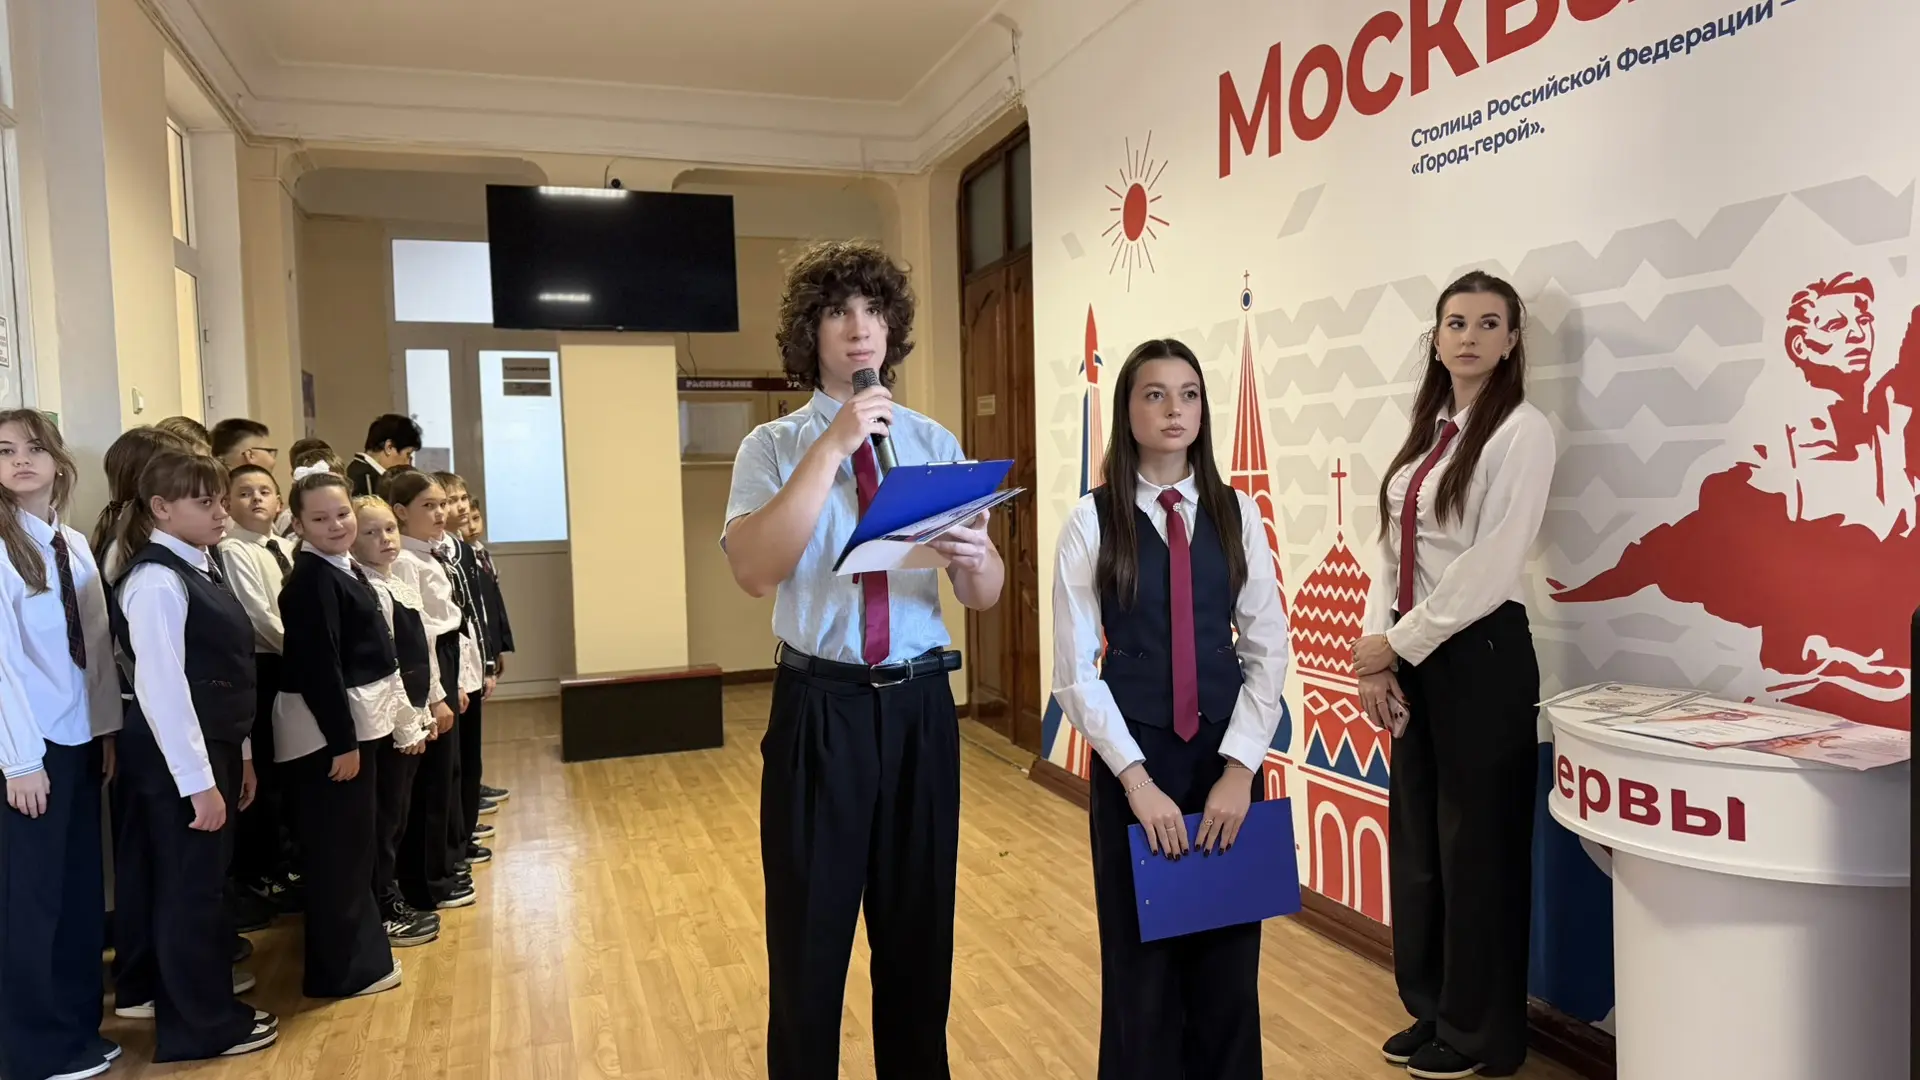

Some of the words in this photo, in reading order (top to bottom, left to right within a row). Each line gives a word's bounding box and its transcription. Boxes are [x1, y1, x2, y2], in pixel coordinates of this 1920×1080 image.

[1219, 0, 1637, 179] Москв
[1411, 107, 1483, 149] Столица
[1487, 56, 1610, 121] Российской
[1617, 0, 1774, 72] Федерации
[1411, 119, 1546, 176] «Город-герой».
[685, 380, 753, 388] РАСПИСАНИЕ
[1554, 752, 1747, 843] ервы
